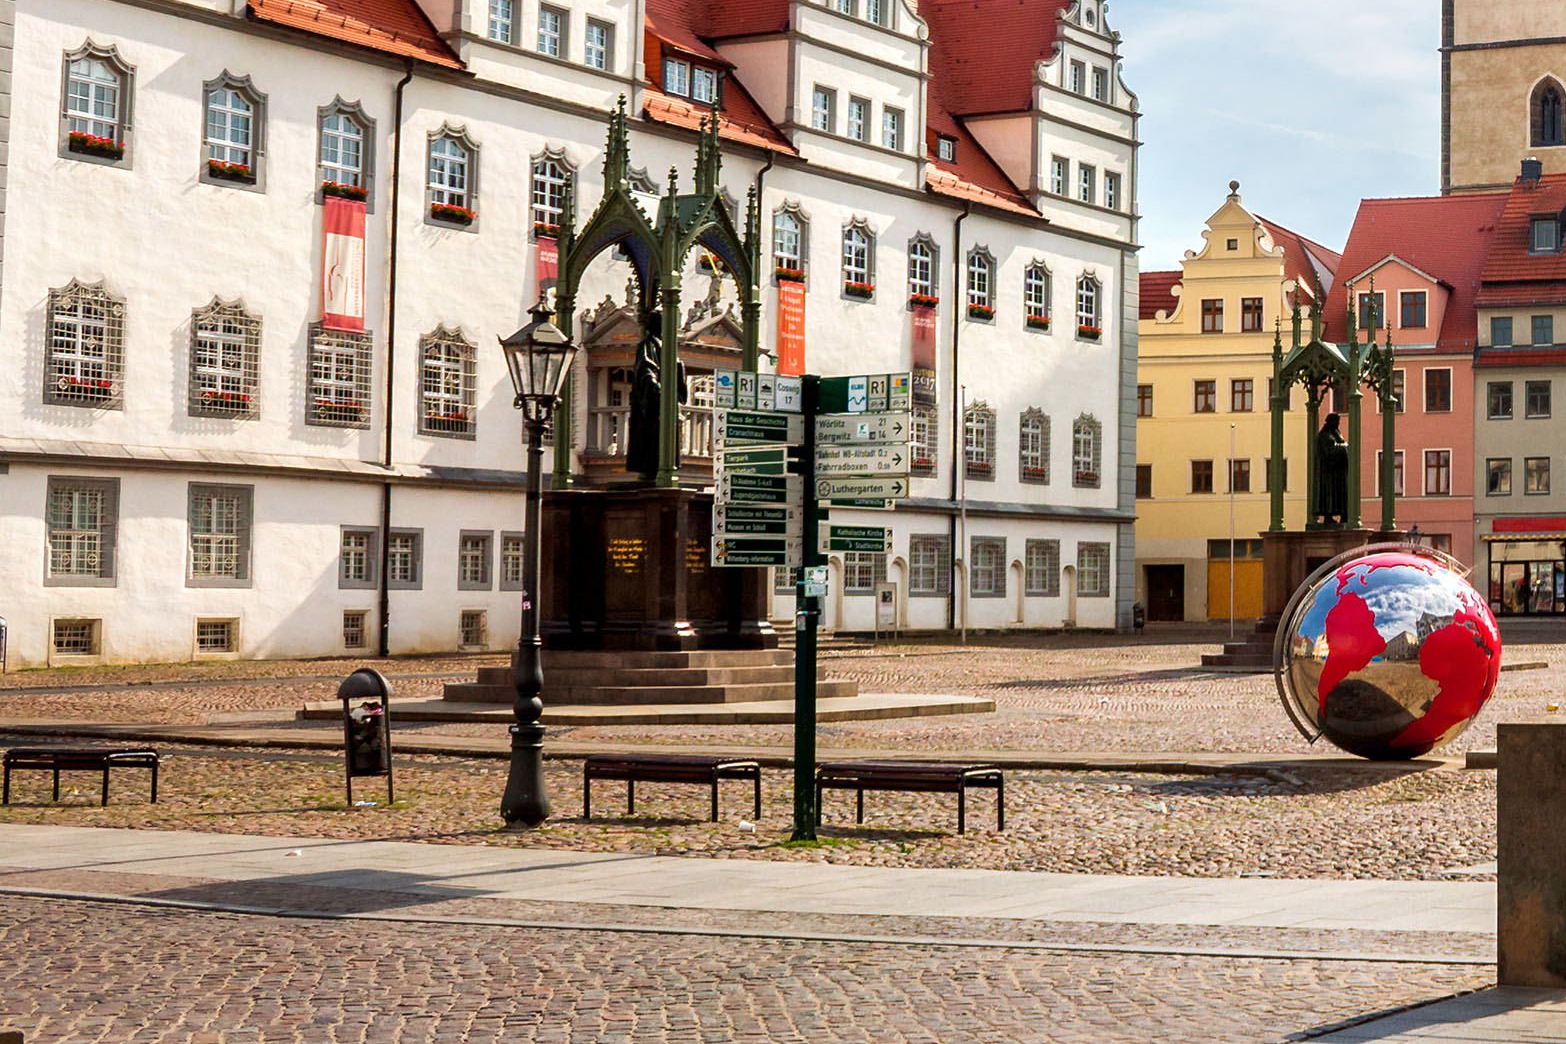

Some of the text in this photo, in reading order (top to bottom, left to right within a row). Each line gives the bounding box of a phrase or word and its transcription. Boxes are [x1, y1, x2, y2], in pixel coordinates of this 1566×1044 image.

[740, 378, 753, 392] R1
[871, 380, 885, 394] R1
[914, 376, 936, 390] 2017
[777, 383, 800, 395] Coswig
[785, 396, 793, 405] 17
[819, 418, 887, 429] Wörlitz 21
[728, 428, 765, 438] Cranachhaus
[818, 432, 851, 442] Bergwitz
[818, 462, 868, 471] Fahrradboxen
[832, 484, 884, 495] Luthergarten
